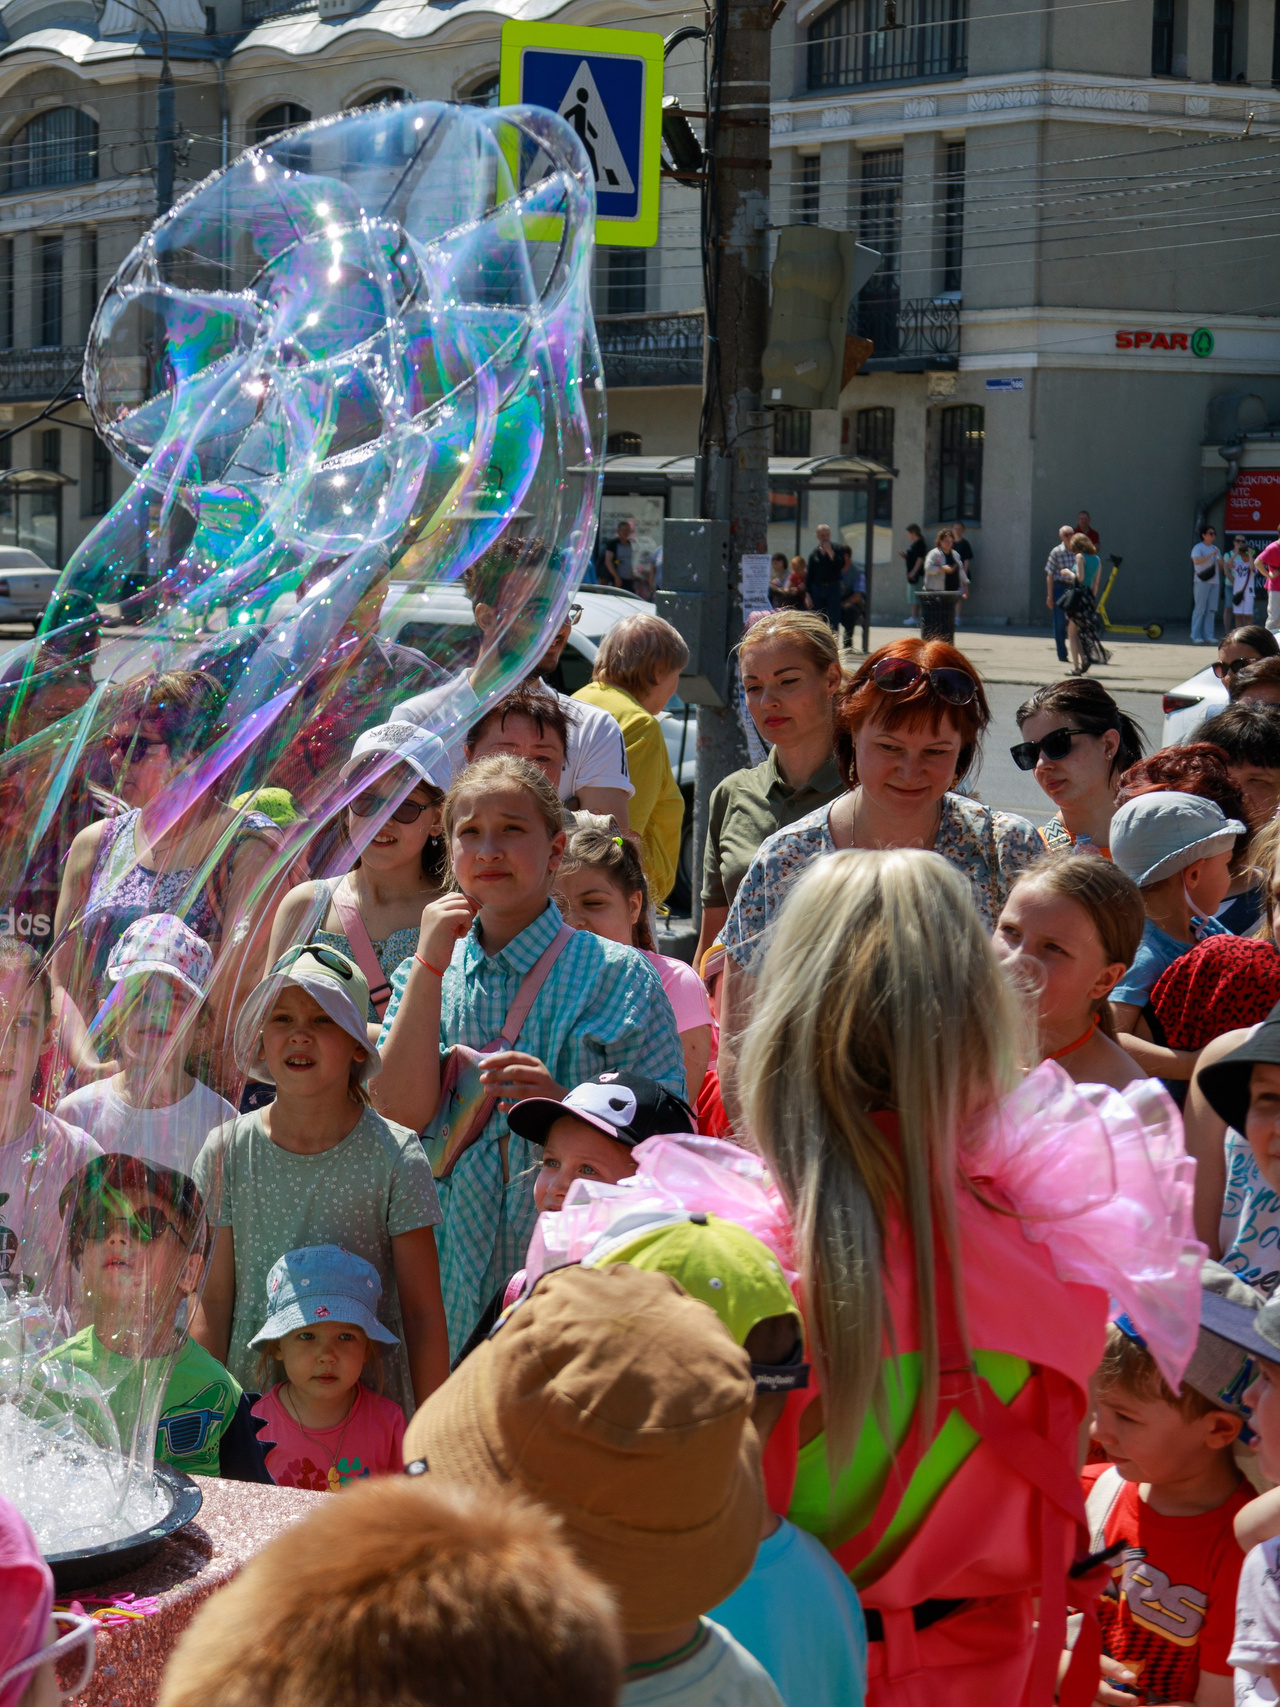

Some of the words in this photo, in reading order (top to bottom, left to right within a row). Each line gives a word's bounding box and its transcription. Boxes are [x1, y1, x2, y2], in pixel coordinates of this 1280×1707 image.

[1116, 330, 1188, 350] SPAR
[1235, 475, 1280, 486] ОДКЛЮЧ
[1230, 498, 1261, 508] ЗДЕСЬ
